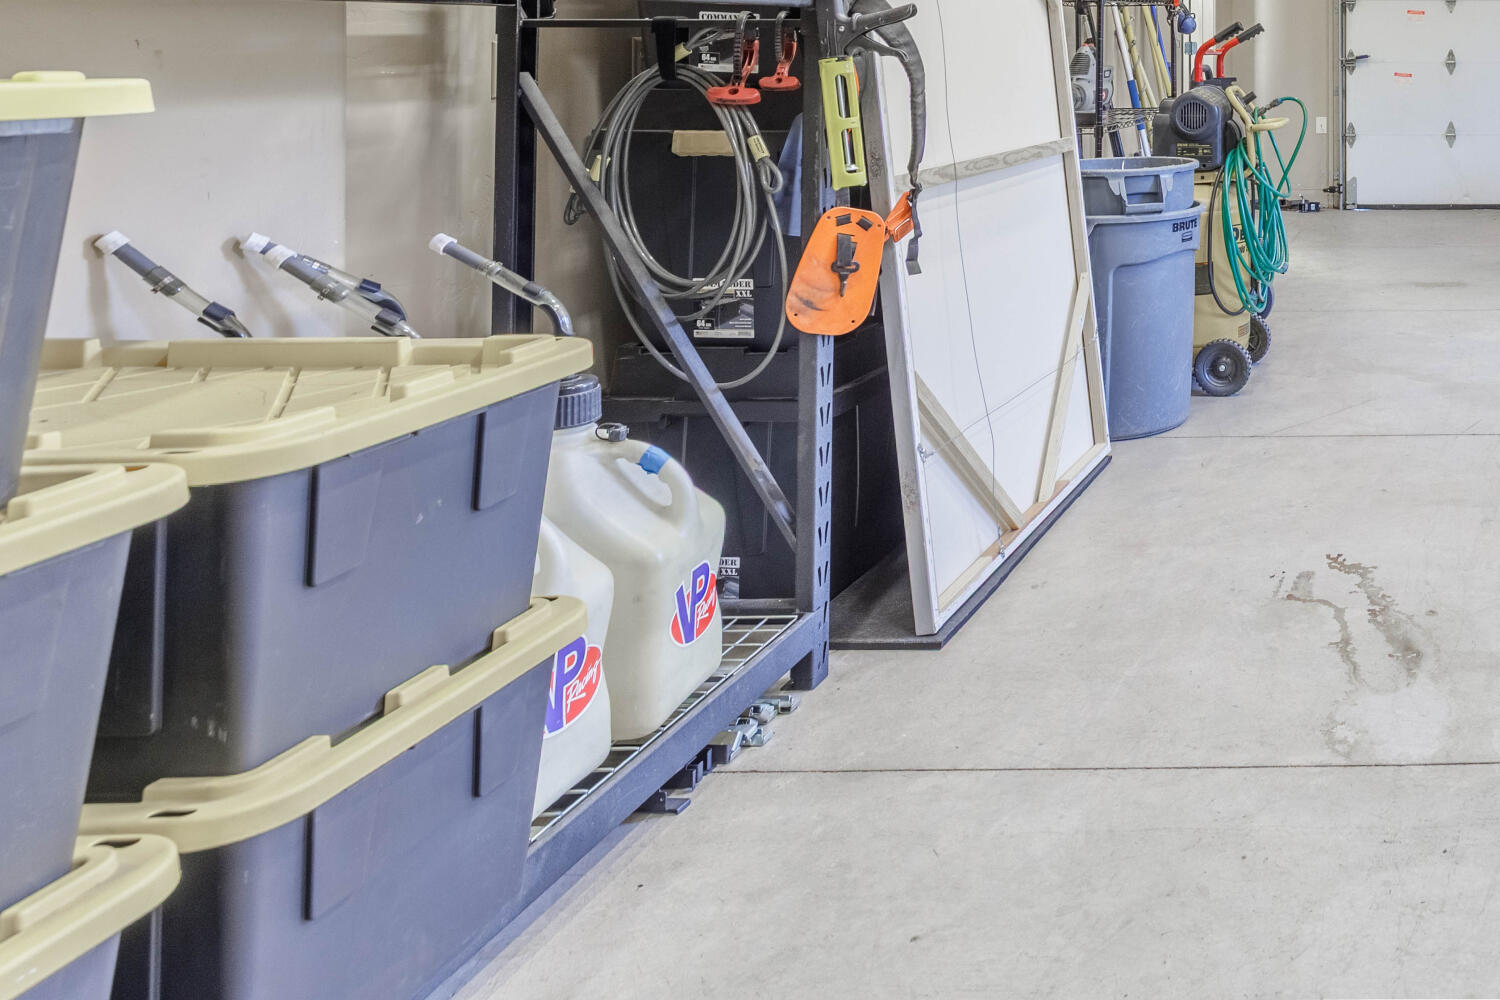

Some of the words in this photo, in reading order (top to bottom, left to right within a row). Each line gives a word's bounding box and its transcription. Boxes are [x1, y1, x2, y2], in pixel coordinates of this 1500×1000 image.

[1172, 218, 1198, 233] BRUTE
[735, 290, 753, 298] XXL
[720, 568, 738, 576] XXL
[675, 560, 711, 645] VP
[566, 657, 601, 713] Racing
